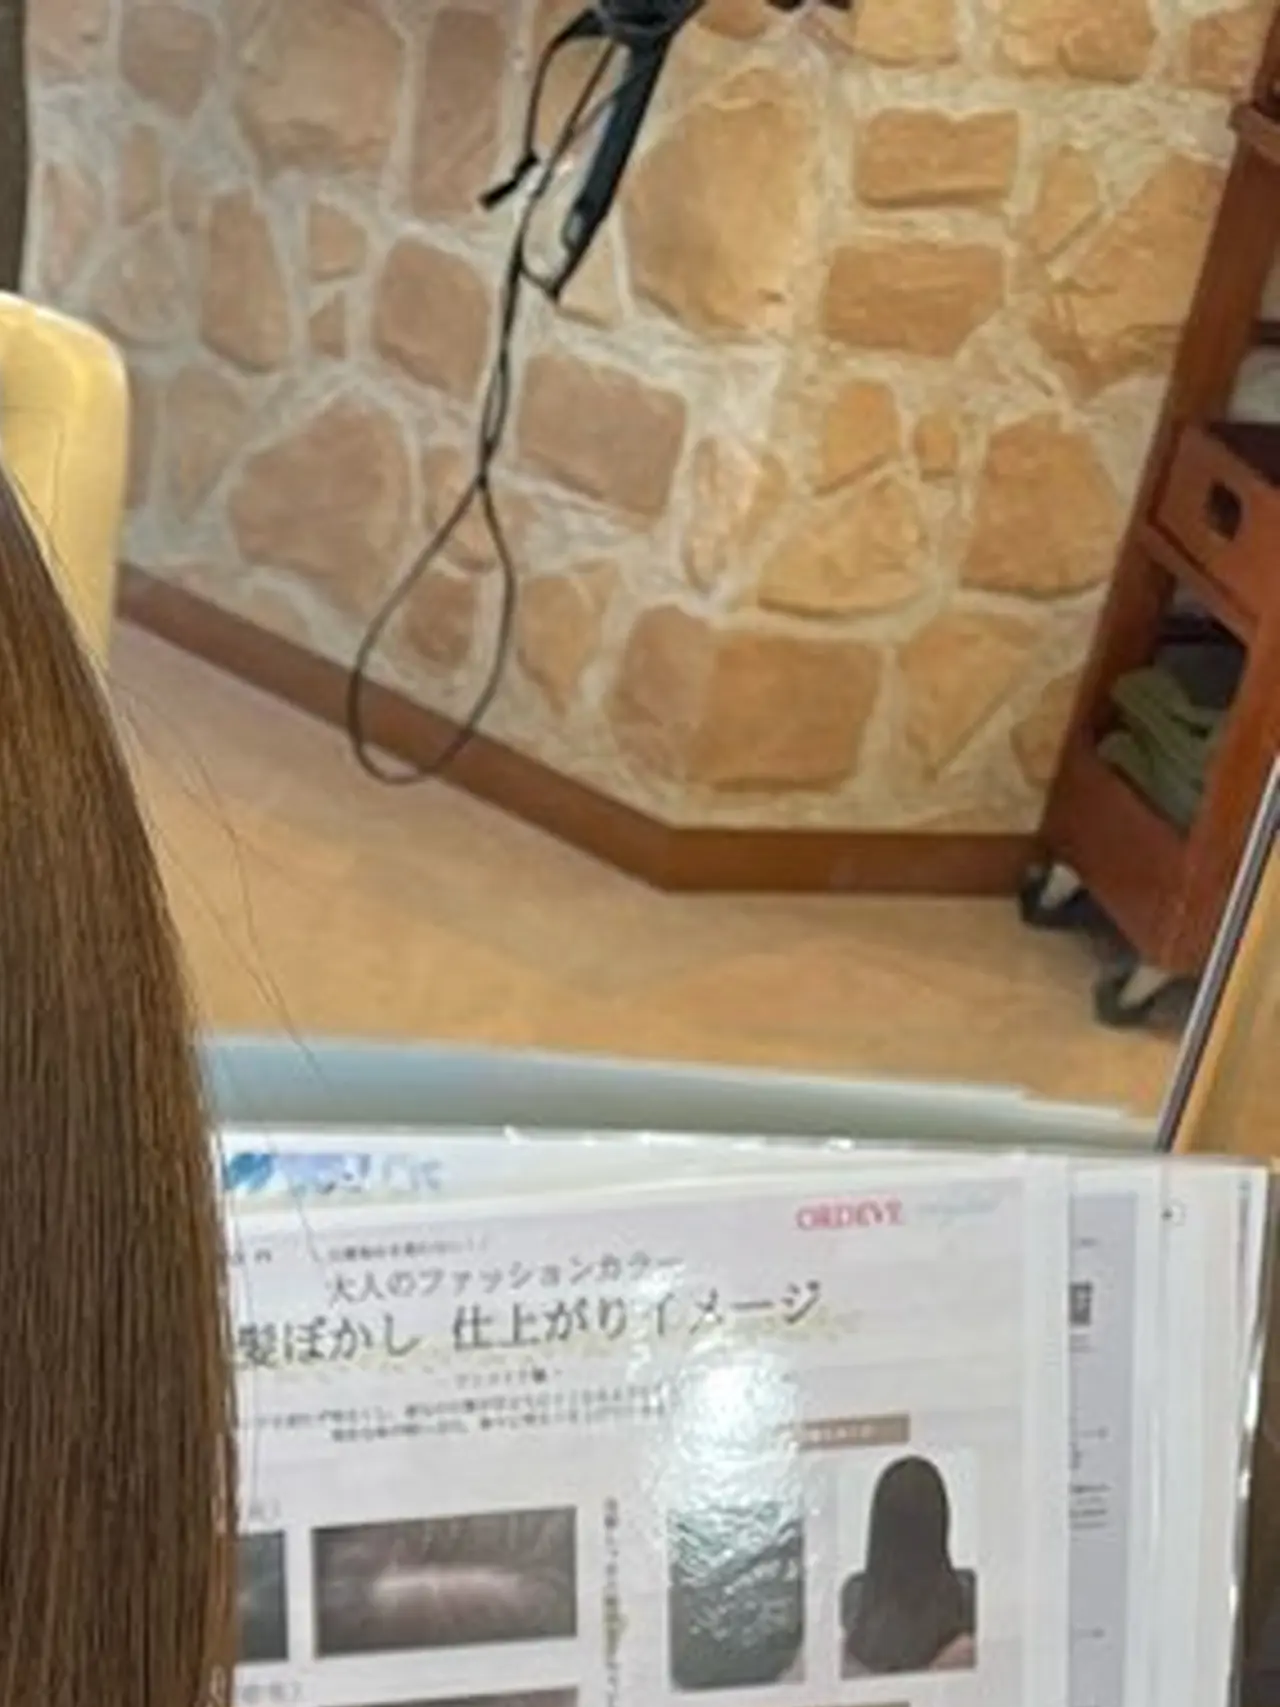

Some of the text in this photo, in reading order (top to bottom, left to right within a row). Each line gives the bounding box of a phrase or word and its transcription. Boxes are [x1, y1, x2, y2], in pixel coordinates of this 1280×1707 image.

[326, 1250, 685, 1302] 大人のファッションカラー
[452, 1278, 822, 1352] 仕上がりイメージ
